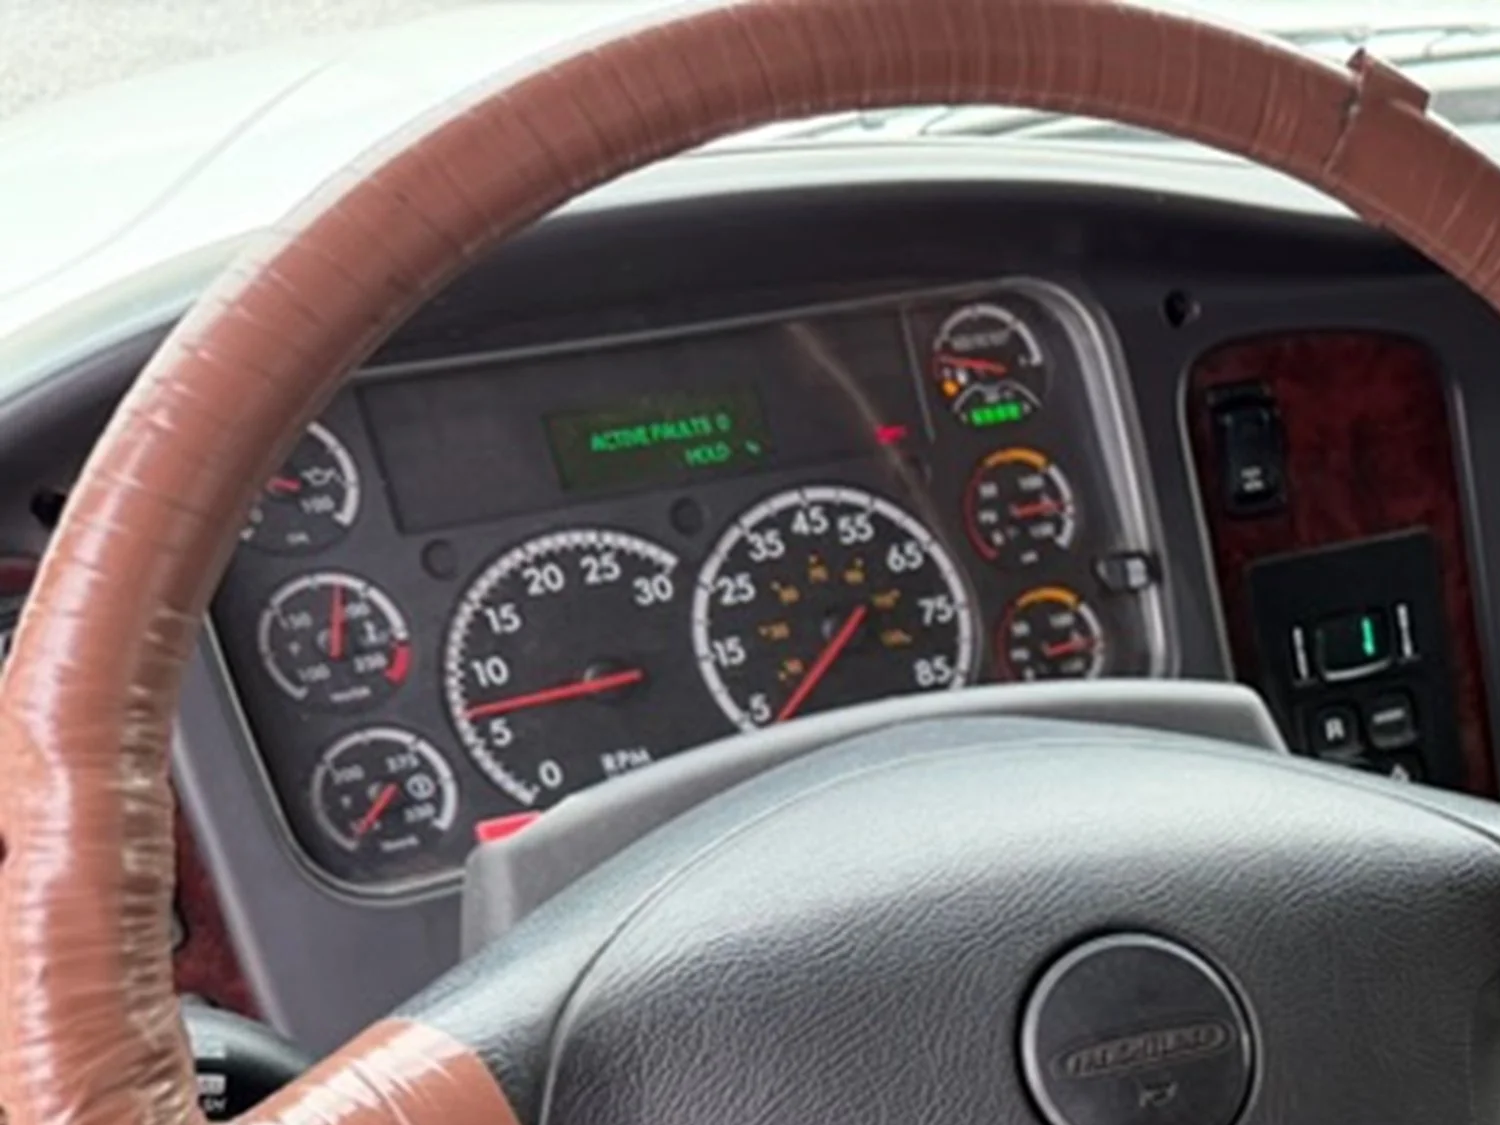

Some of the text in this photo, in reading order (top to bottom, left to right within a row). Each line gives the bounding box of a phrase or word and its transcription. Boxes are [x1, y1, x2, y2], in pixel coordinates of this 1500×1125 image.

[591, 426, 649, 452] ACTIVE
[651, 415, 713, 442] FAULTS
[685, 440, 730, 467] HOLD
[791, 505, 829, 535] 45
[837, 513, 874, 545] 55
[750, 529, 785, 561] 35
[887, 541, 923, 572] 65
[522, 563, 565, 596] 20
[580, 552, 621, 584] 25
[633, 574, 674, 606] 30
[717, 572, 756, 605] 25
[484, 603, 522, 633] 15
[918, 595, 953, 626] 75
[713, 637, 746, 667] 15
[471, 656, 509, 687] 10
[914, 656, 951, 686] 85
[751, 694, 771, 722] 5
[489, 717, 513, 746] 5
[1326, 718, 1345, 740] R
[538, 759, 563, 788] 0
[602, 748, 652, 772] RPM
